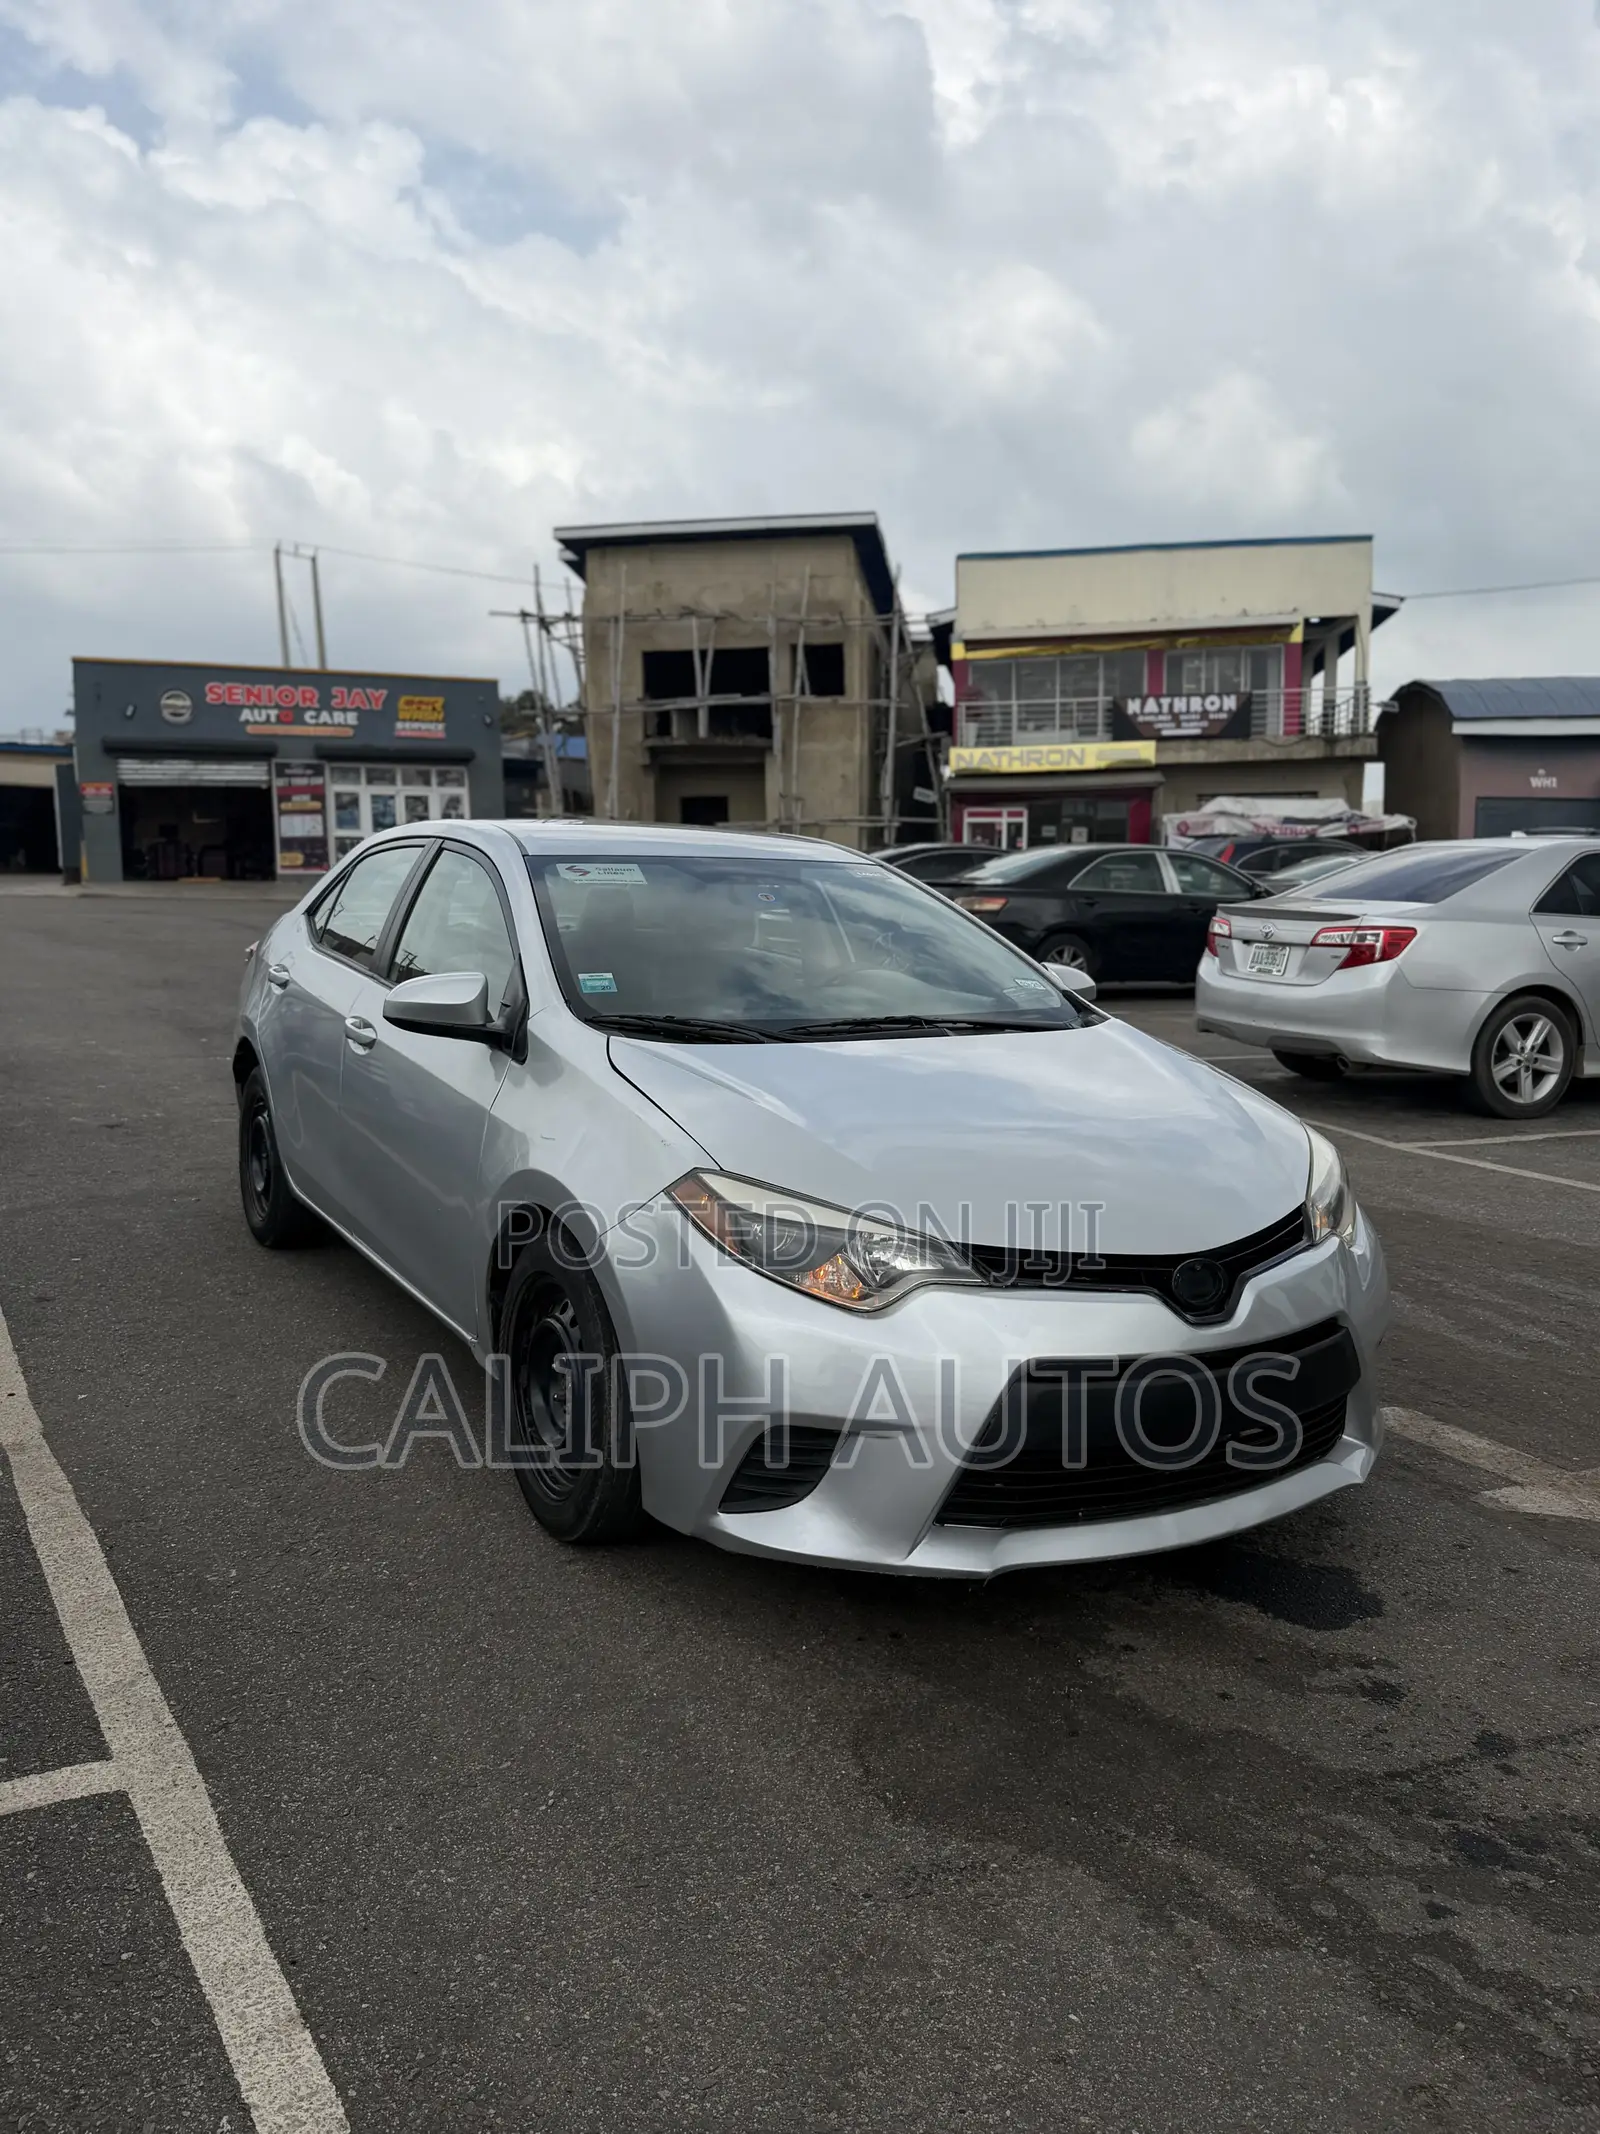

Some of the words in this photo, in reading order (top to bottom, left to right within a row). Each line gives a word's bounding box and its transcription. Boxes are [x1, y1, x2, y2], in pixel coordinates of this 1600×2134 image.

[205, 682, 319, 708] SENIOR
[331, 686, 389, 711] JAY
[1126, 694, 1237, 715] NATHRON
[304, 710, 359, 726] CARE
[955, 748, 1086, 770] NATHRON
